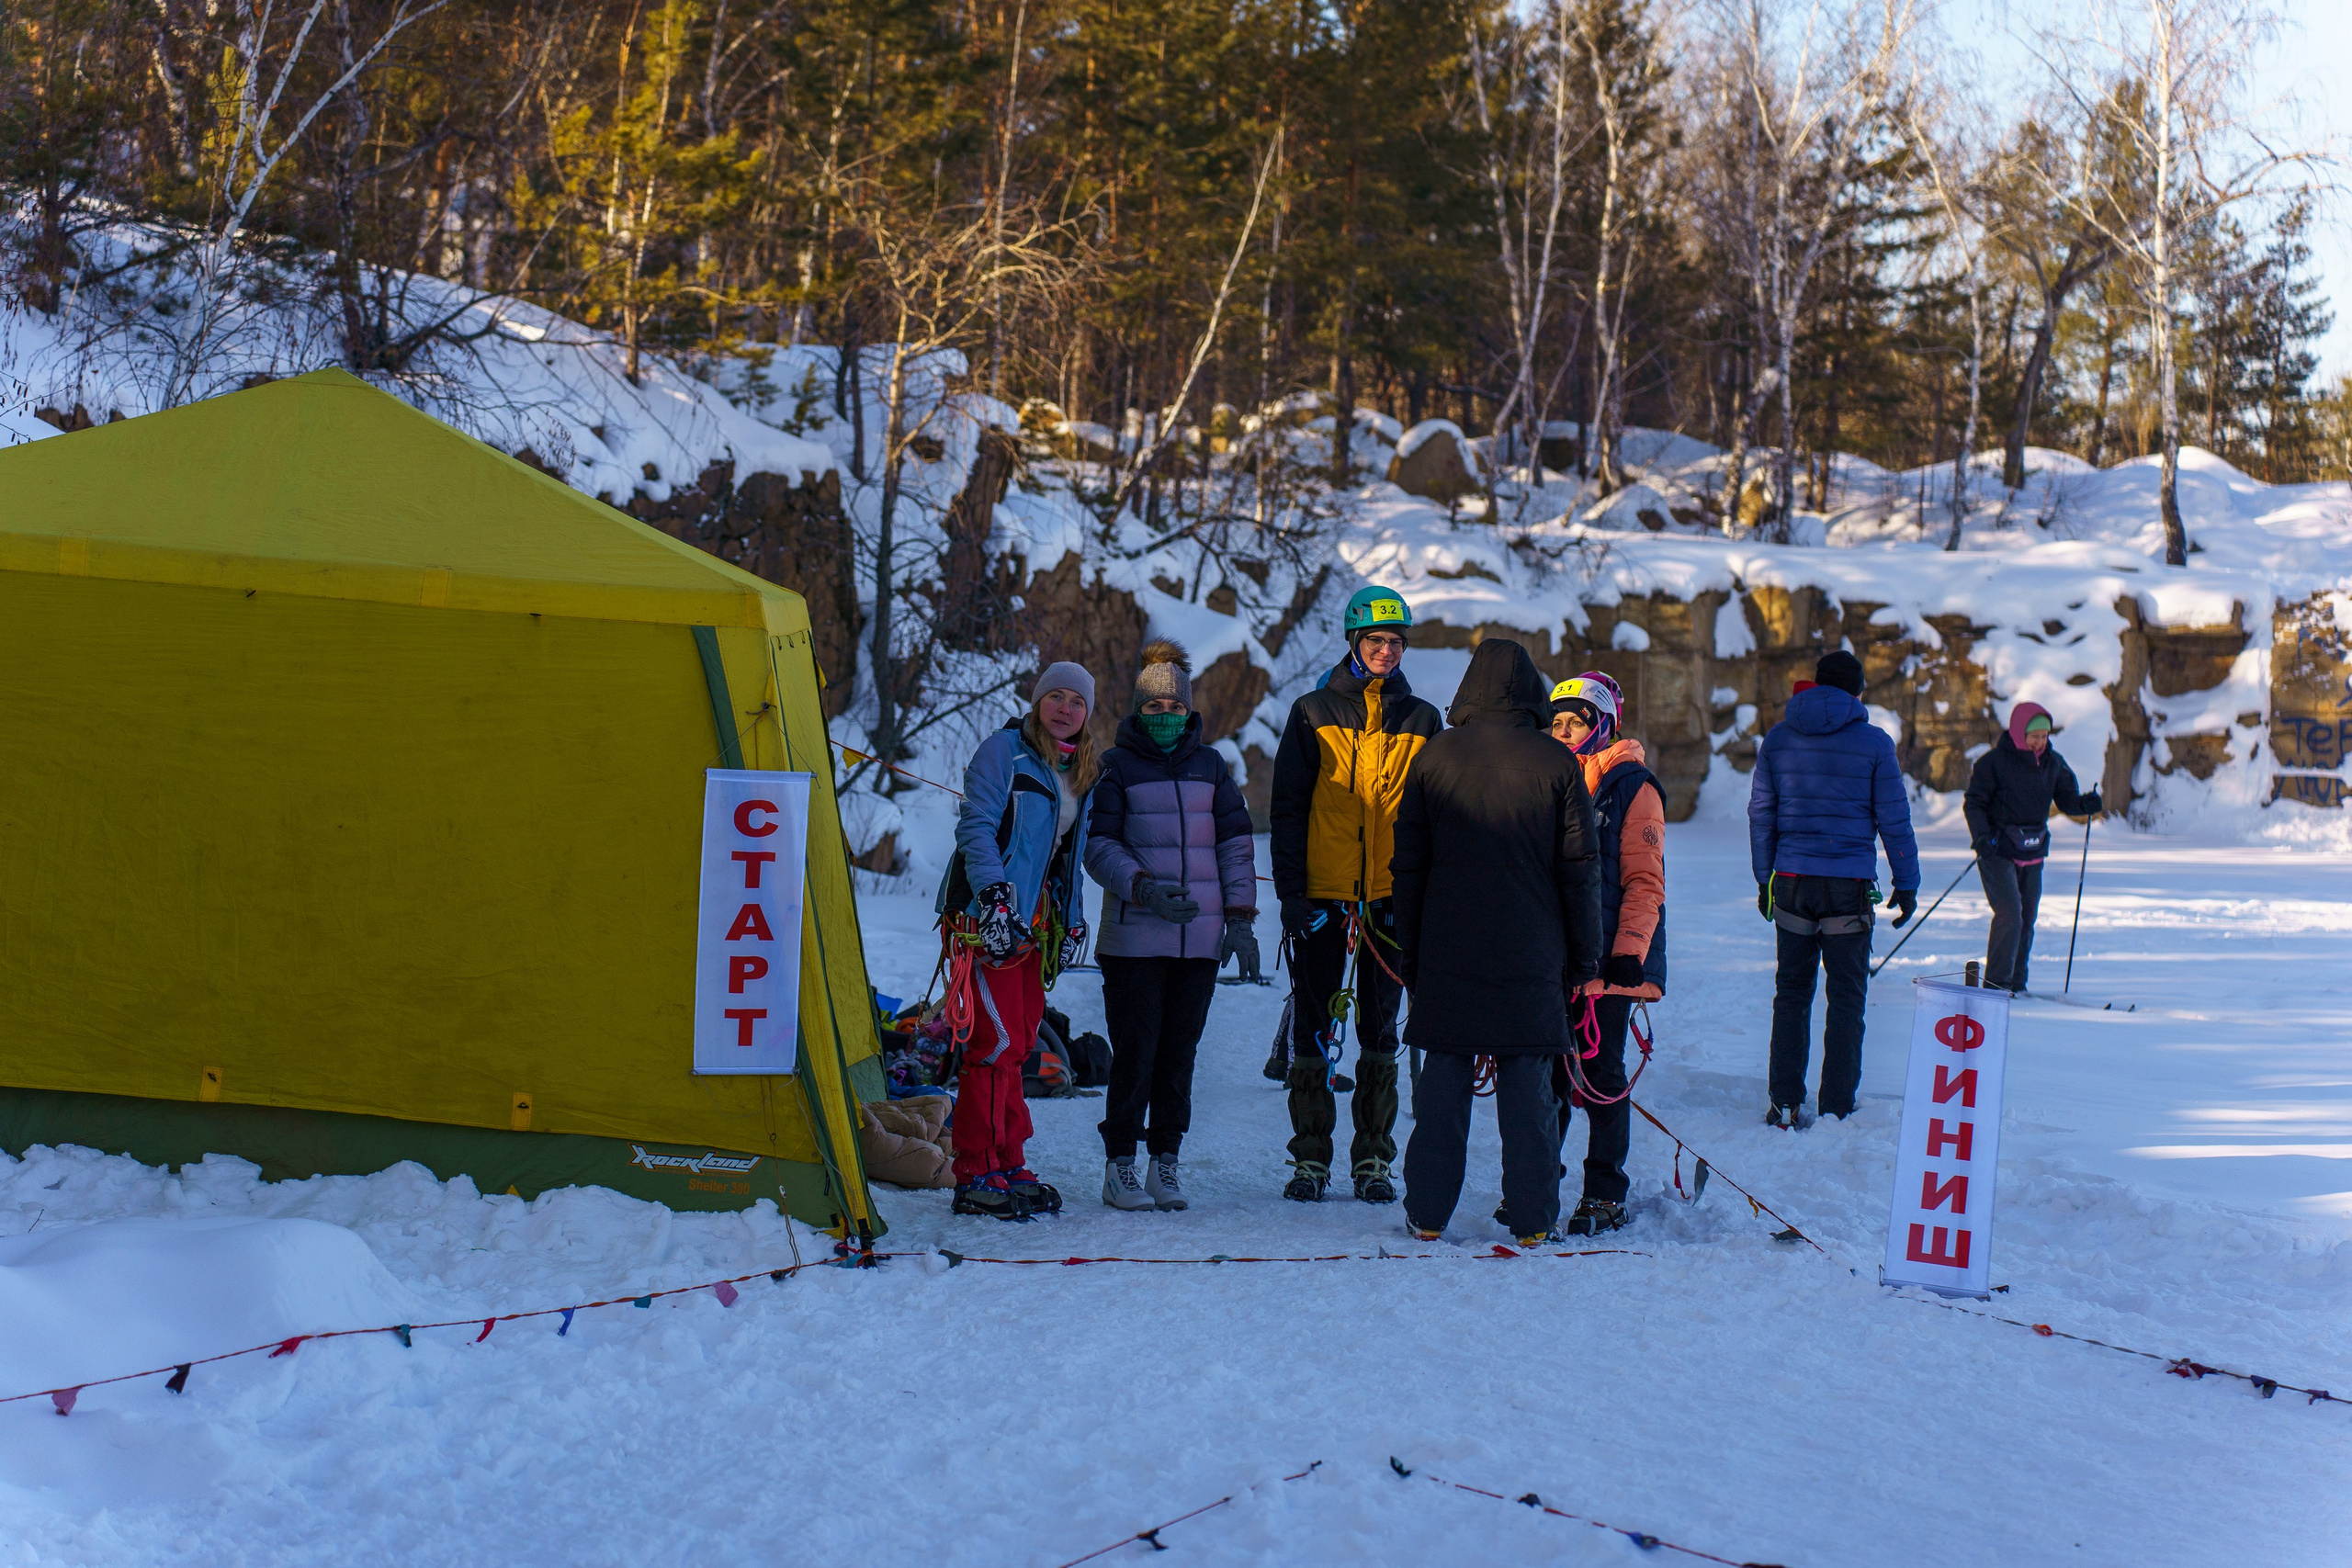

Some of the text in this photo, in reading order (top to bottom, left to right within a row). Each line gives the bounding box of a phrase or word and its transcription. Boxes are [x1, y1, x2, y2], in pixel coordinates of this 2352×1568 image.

[1379, 604, 1397, 615] 3.2
[1556, 683, 1573, 694] 3.1
[724, 799, 780, 1047] СТАРТ
[1905, 1013, 1985, 1269] ФИНИШ
[688, 1178, 751, 1195] Shelter 380
